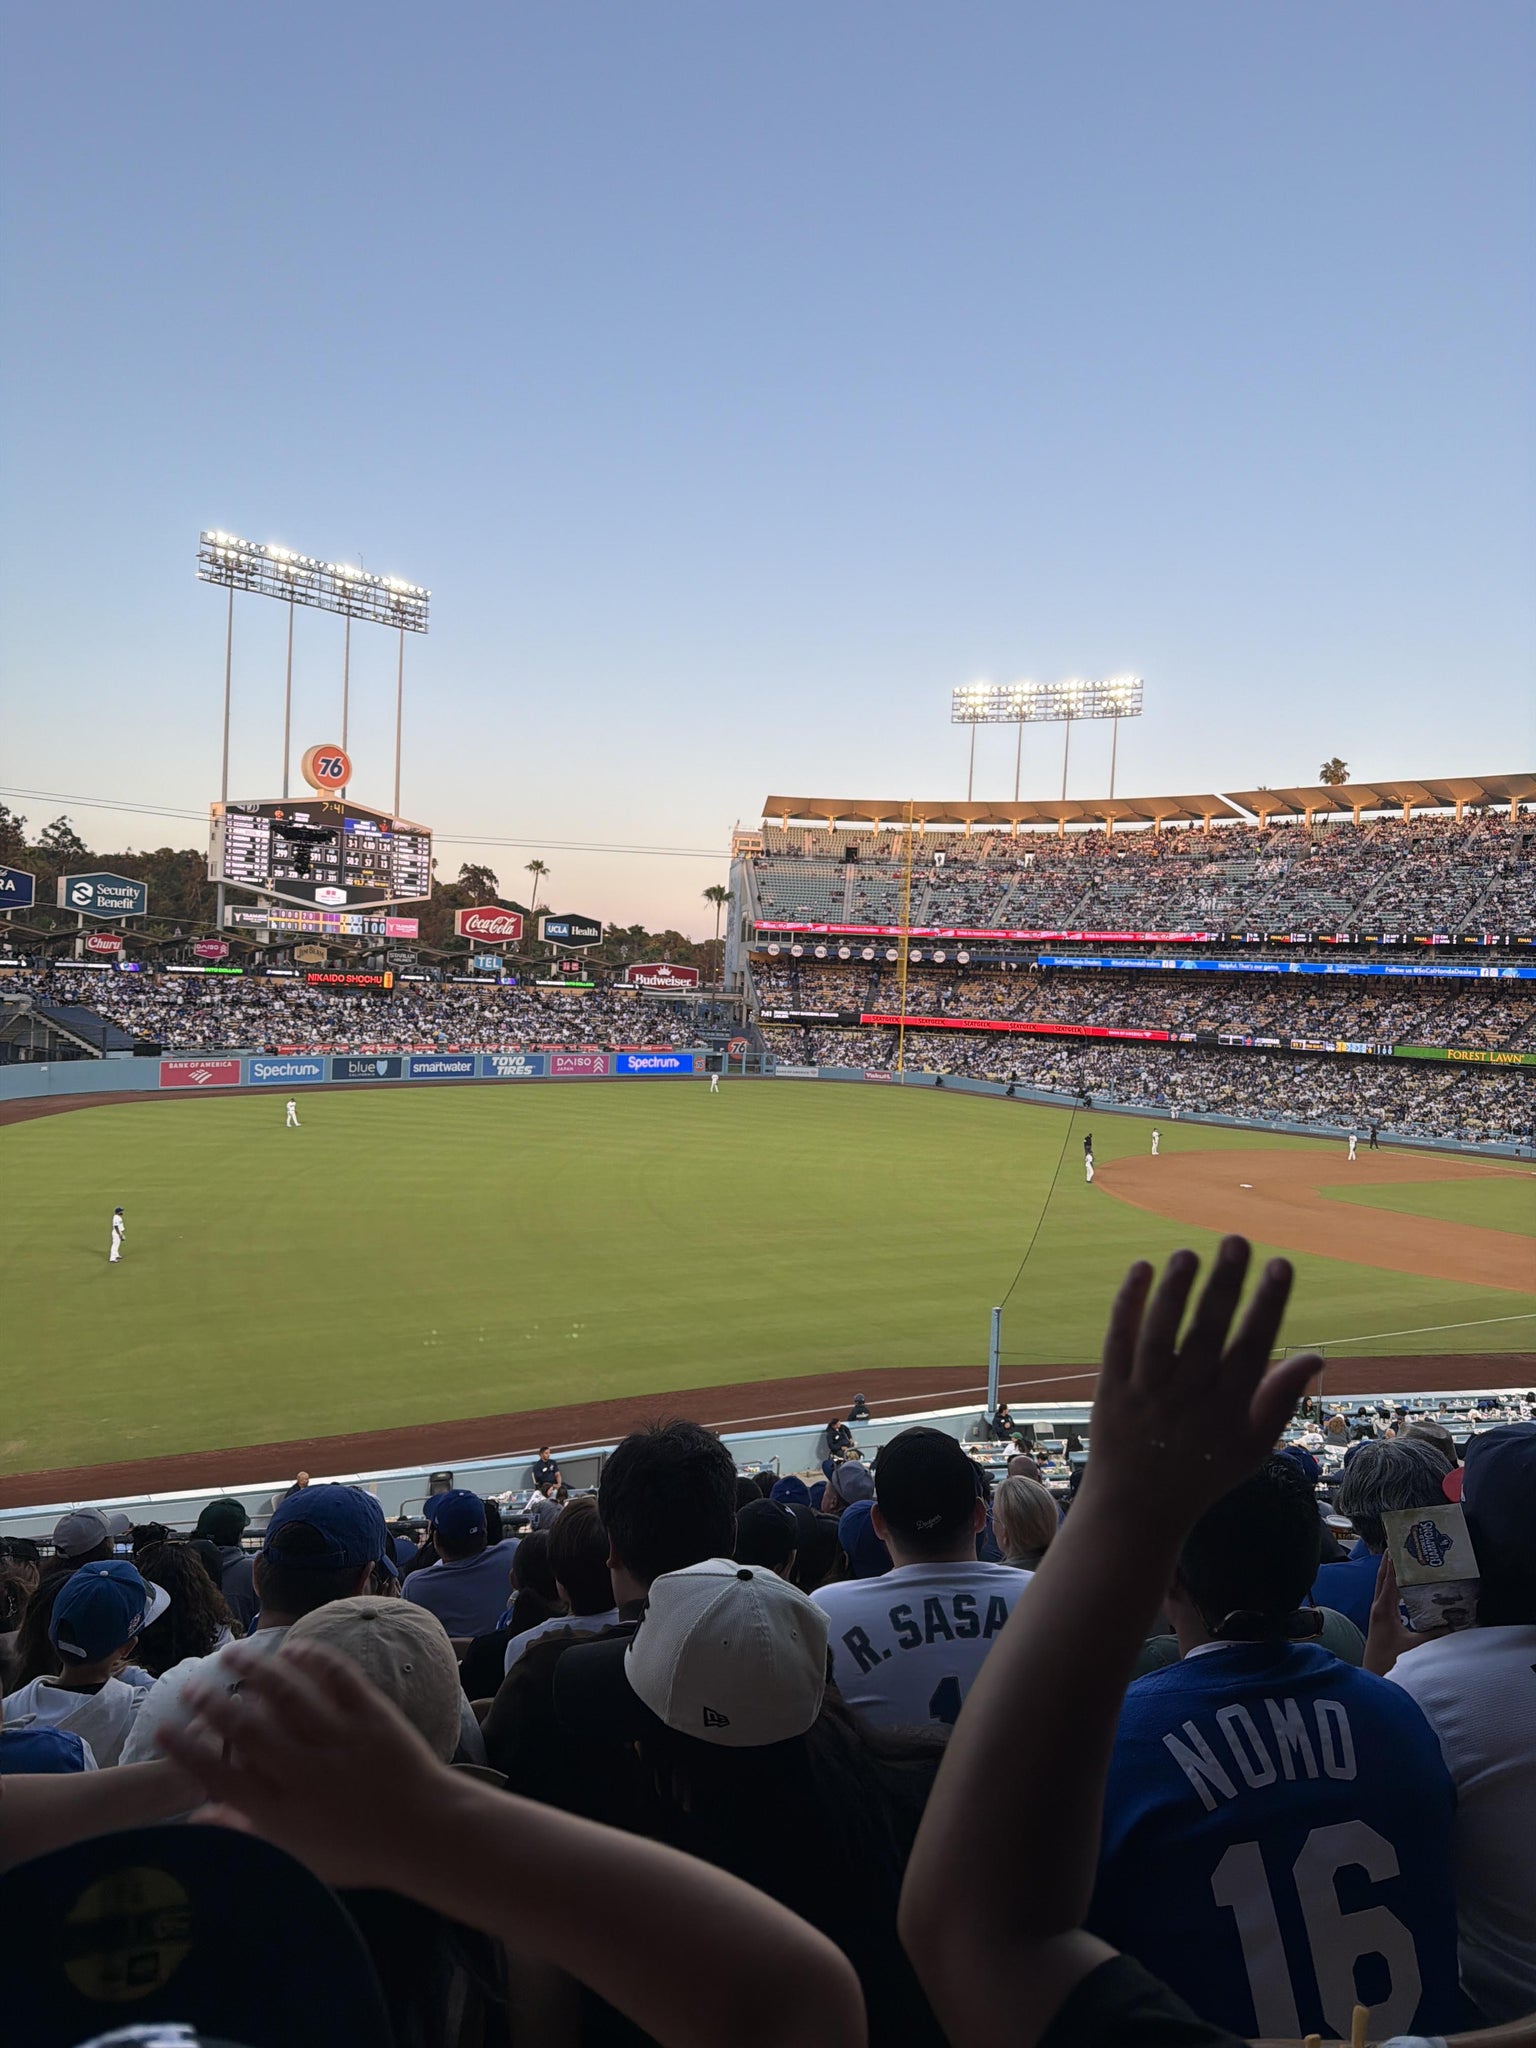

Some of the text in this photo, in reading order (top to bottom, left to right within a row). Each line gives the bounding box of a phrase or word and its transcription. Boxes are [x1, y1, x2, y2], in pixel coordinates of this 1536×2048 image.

[318, 756, 344, 779] 76
[322, 802, 344, 814] 7:41
[97, 883, 140, 899] Security
[97, 896, 134, 910] Benefit
[466, 914, 516, 935] Coca-Cola
[547, 924, 598, 938] UCLA Health
[88, 936, 121, 950] Churu
[478, 956, 500, 968] TEL
[308, 973, 345, 982] NIKAIDO
[346, 975, 382, 984] SHOCHU
[1413, 967, 1477, 976] @SoCalHondaDealers
[635, 974, 692, 987] Budweiser
[732, 1042, 746, 1053] 76
[492, 1057, 524, 1066] TOYO
[557, 1058, 591, 1066] DAISO
[1447, 1049, 1523, 1063] FOREST LAWN
[349, 1060, 375, 1073] blue
[413, 1061, 471, 1073] smartwater
[497, 1066, 532, 1075] TIRES
[628, 1056, 674, 1071] Spectrum
[254, 1063, 315, 1079] Spectrum
[865, 1072, 891, 1080] Yakult
[1420, 1521, 1442, 1566] CHAMPIONS
[842, 1594, 1009, 1674] R. SASA
[1162, 1698, 1357, 1812] NOMO
[1210, 1820, 1422, 2040] 16
